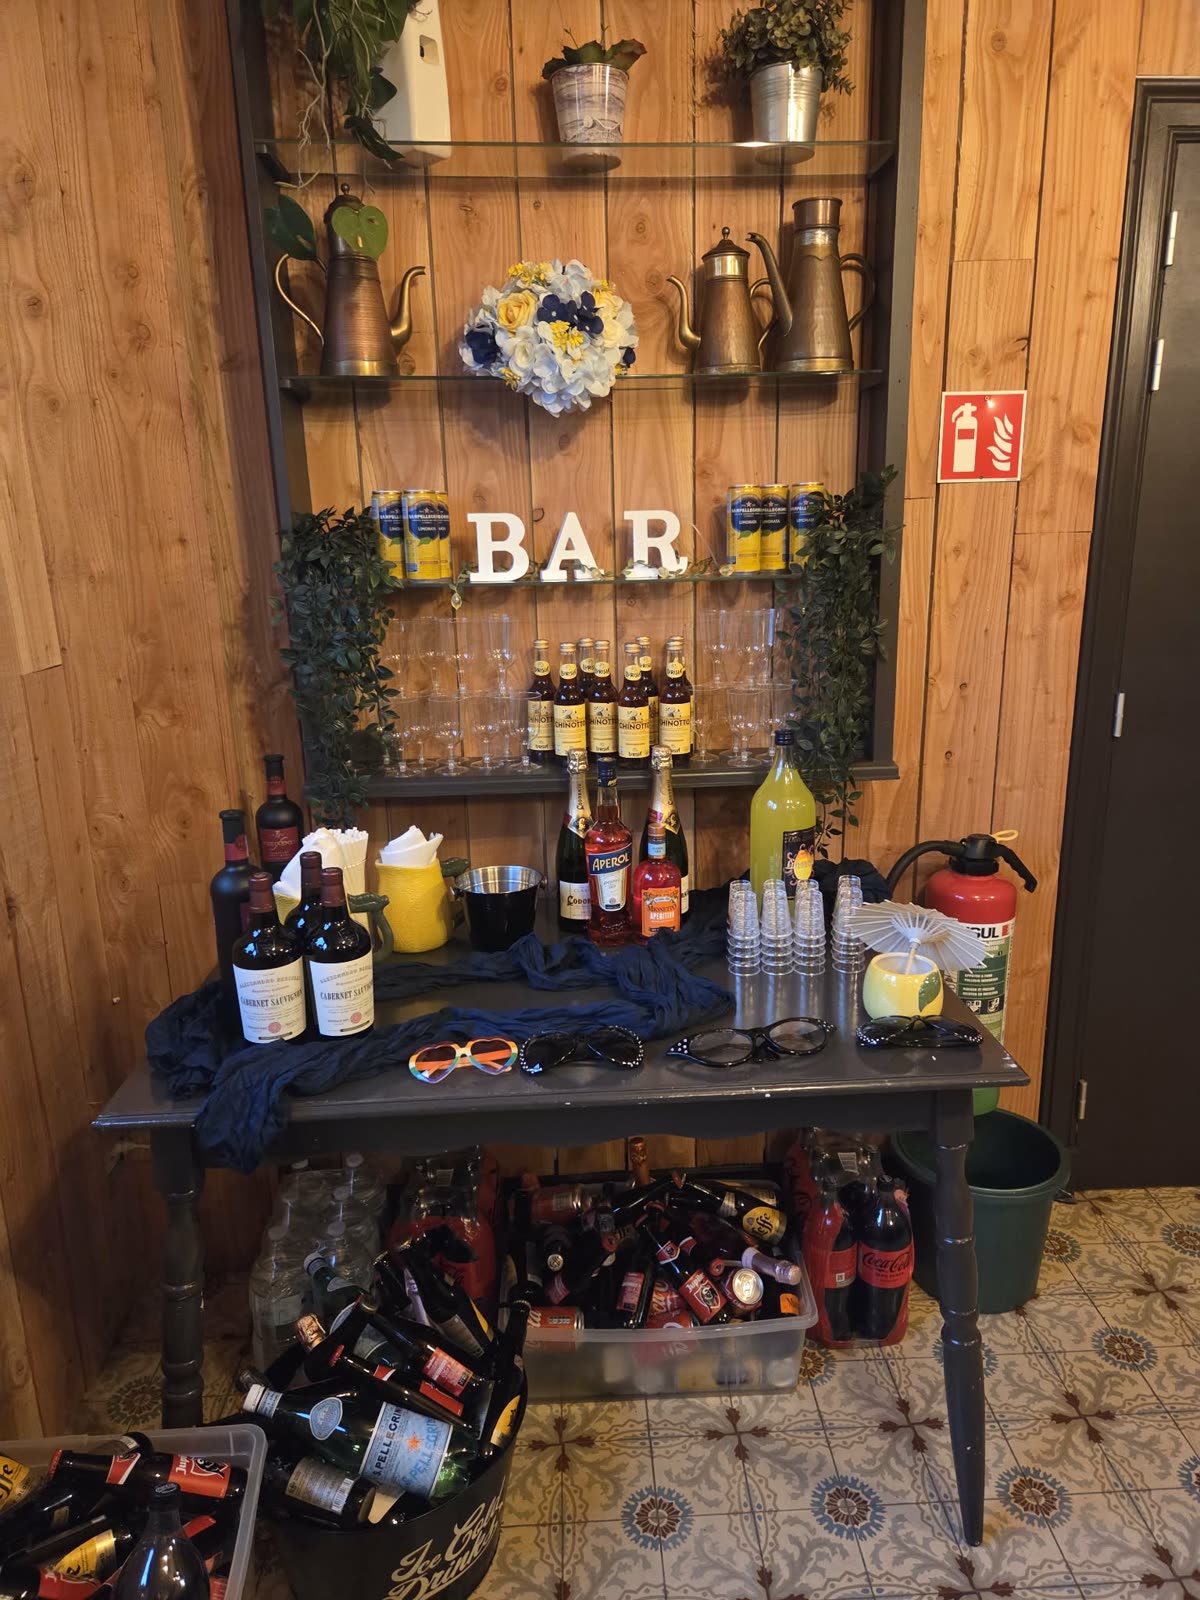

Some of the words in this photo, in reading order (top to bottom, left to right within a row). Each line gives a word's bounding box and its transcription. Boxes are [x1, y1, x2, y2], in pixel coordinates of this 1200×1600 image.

[466, 509, 689, 583] BAR
[592, 852, 629, 871] APEROL
[240, 996, 269, 1007] CABERNET
[320, 990, 352, 1000] CABERNET
[752, 1213, 773, 1235] Leffe
[391, 1538, 442, 1582] Ice
[445, 1496, 504, 1562] Cold
